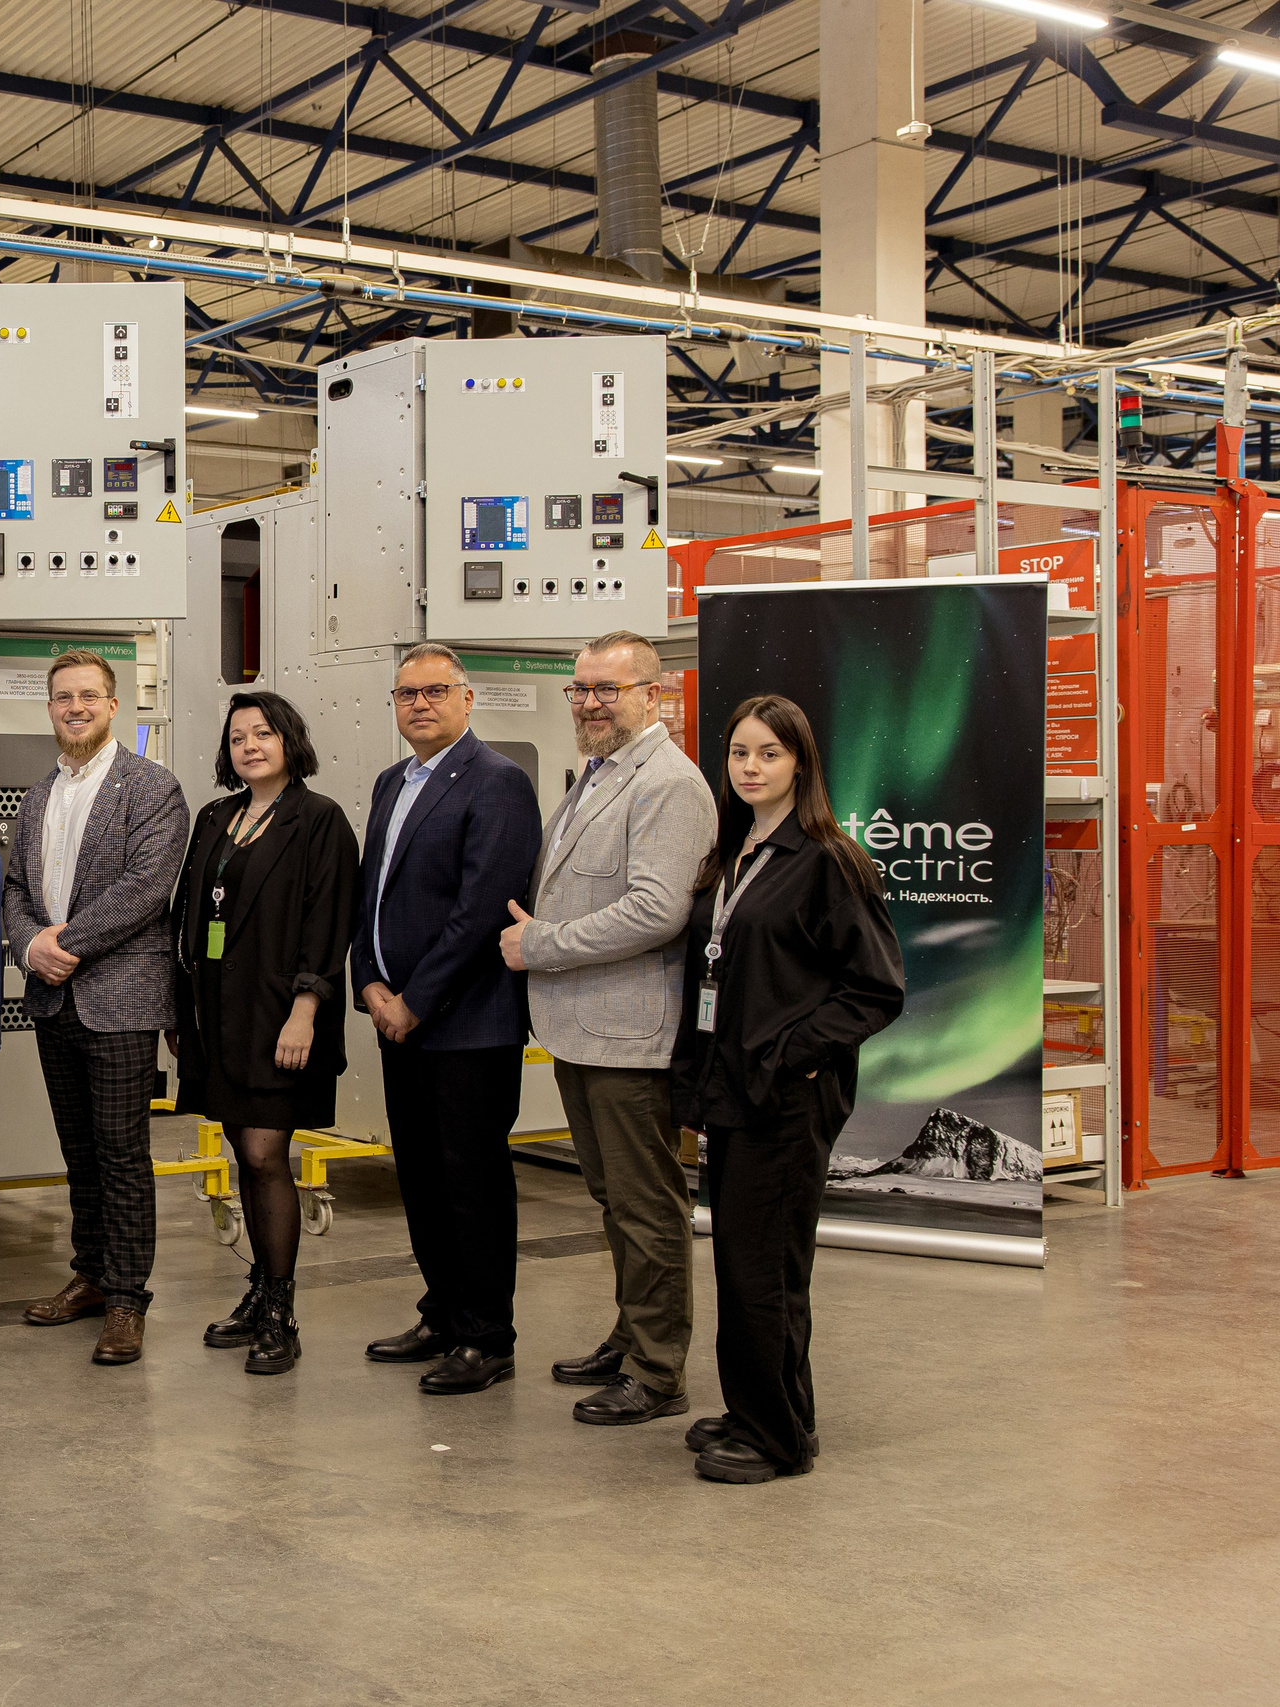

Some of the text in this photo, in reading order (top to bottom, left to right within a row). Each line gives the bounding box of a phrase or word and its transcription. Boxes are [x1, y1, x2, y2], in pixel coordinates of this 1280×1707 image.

[1020, 555, 1064, 573] STOP
[104, 646, 134, 655] MVnex
[525, 661, 553, 671] Systeme
[837, 808, 994, 851] tême
[899, 889, 993, 904] Надежность.
